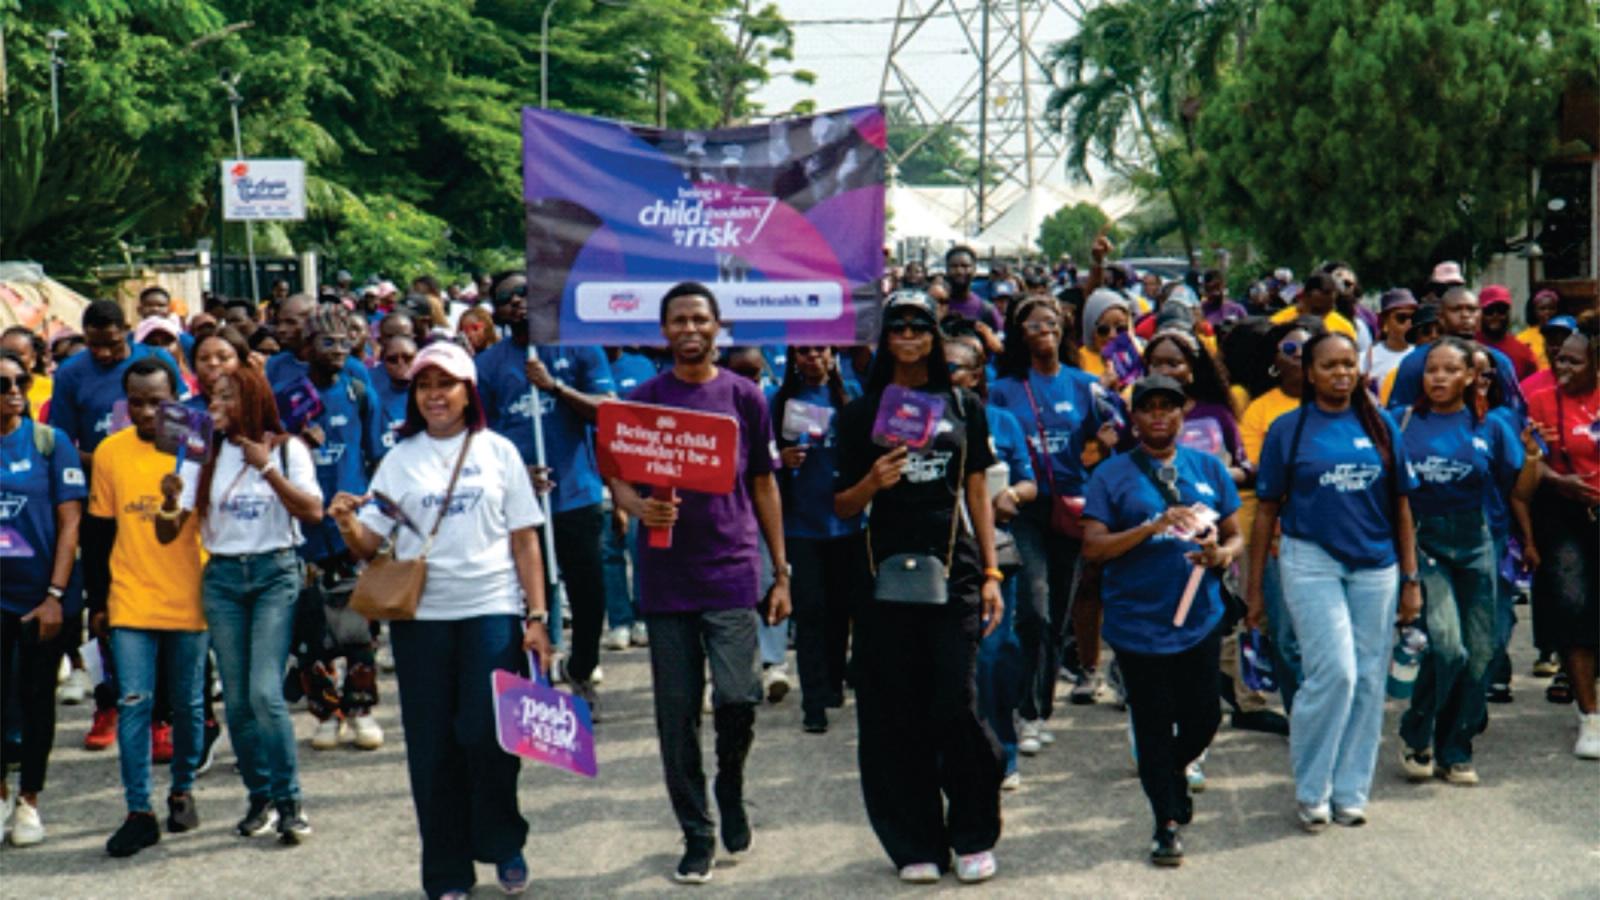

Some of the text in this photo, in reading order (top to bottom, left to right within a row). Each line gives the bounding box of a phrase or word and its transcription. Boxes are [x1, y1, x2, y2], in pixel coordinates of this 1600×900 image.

[638, 199, 704, 226] child
[684, 219, 743, 248] risk
[616, 421, 661, 445] Being
[663, 431, 674, 445] a
[675, 430, 717, 450] child
[609, 436, 721, 468] shouldn't be a
[645, 460, 682, 478] risk!
